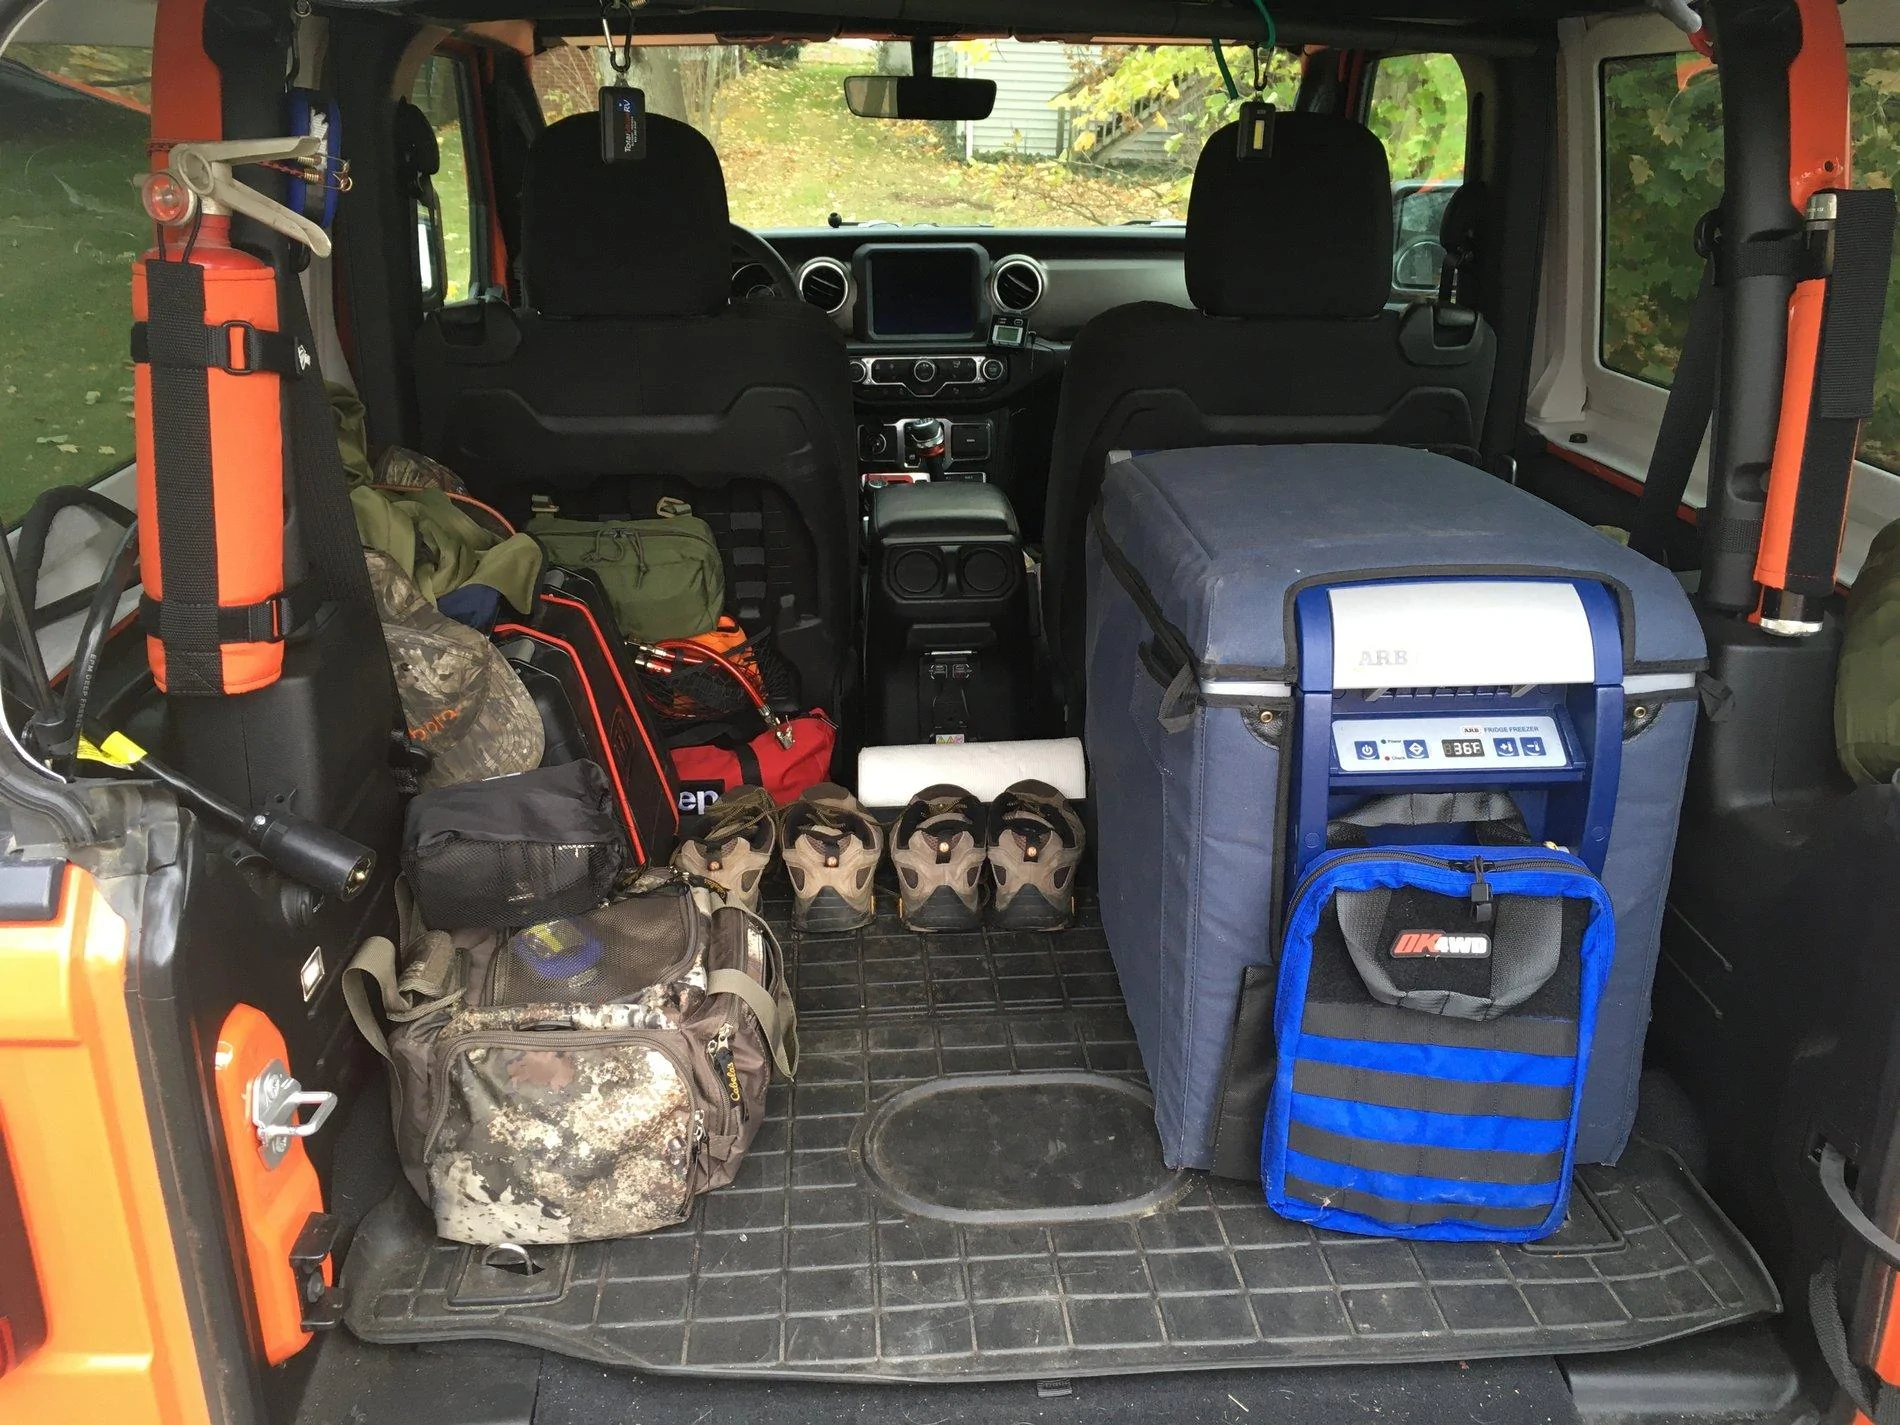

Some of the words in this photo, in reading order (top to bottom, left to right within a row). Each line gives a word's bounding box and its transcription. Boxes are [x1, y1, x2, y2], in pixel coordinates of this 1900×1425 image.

[1358, 650, 1408, 666] ARB
[82, 674, 92, 697] DEEP
[678, 790, 719, 816] ep
[1394, 933, 1488, 954] OK4WD
[726, 1062, 740, 1101] Cabela's
